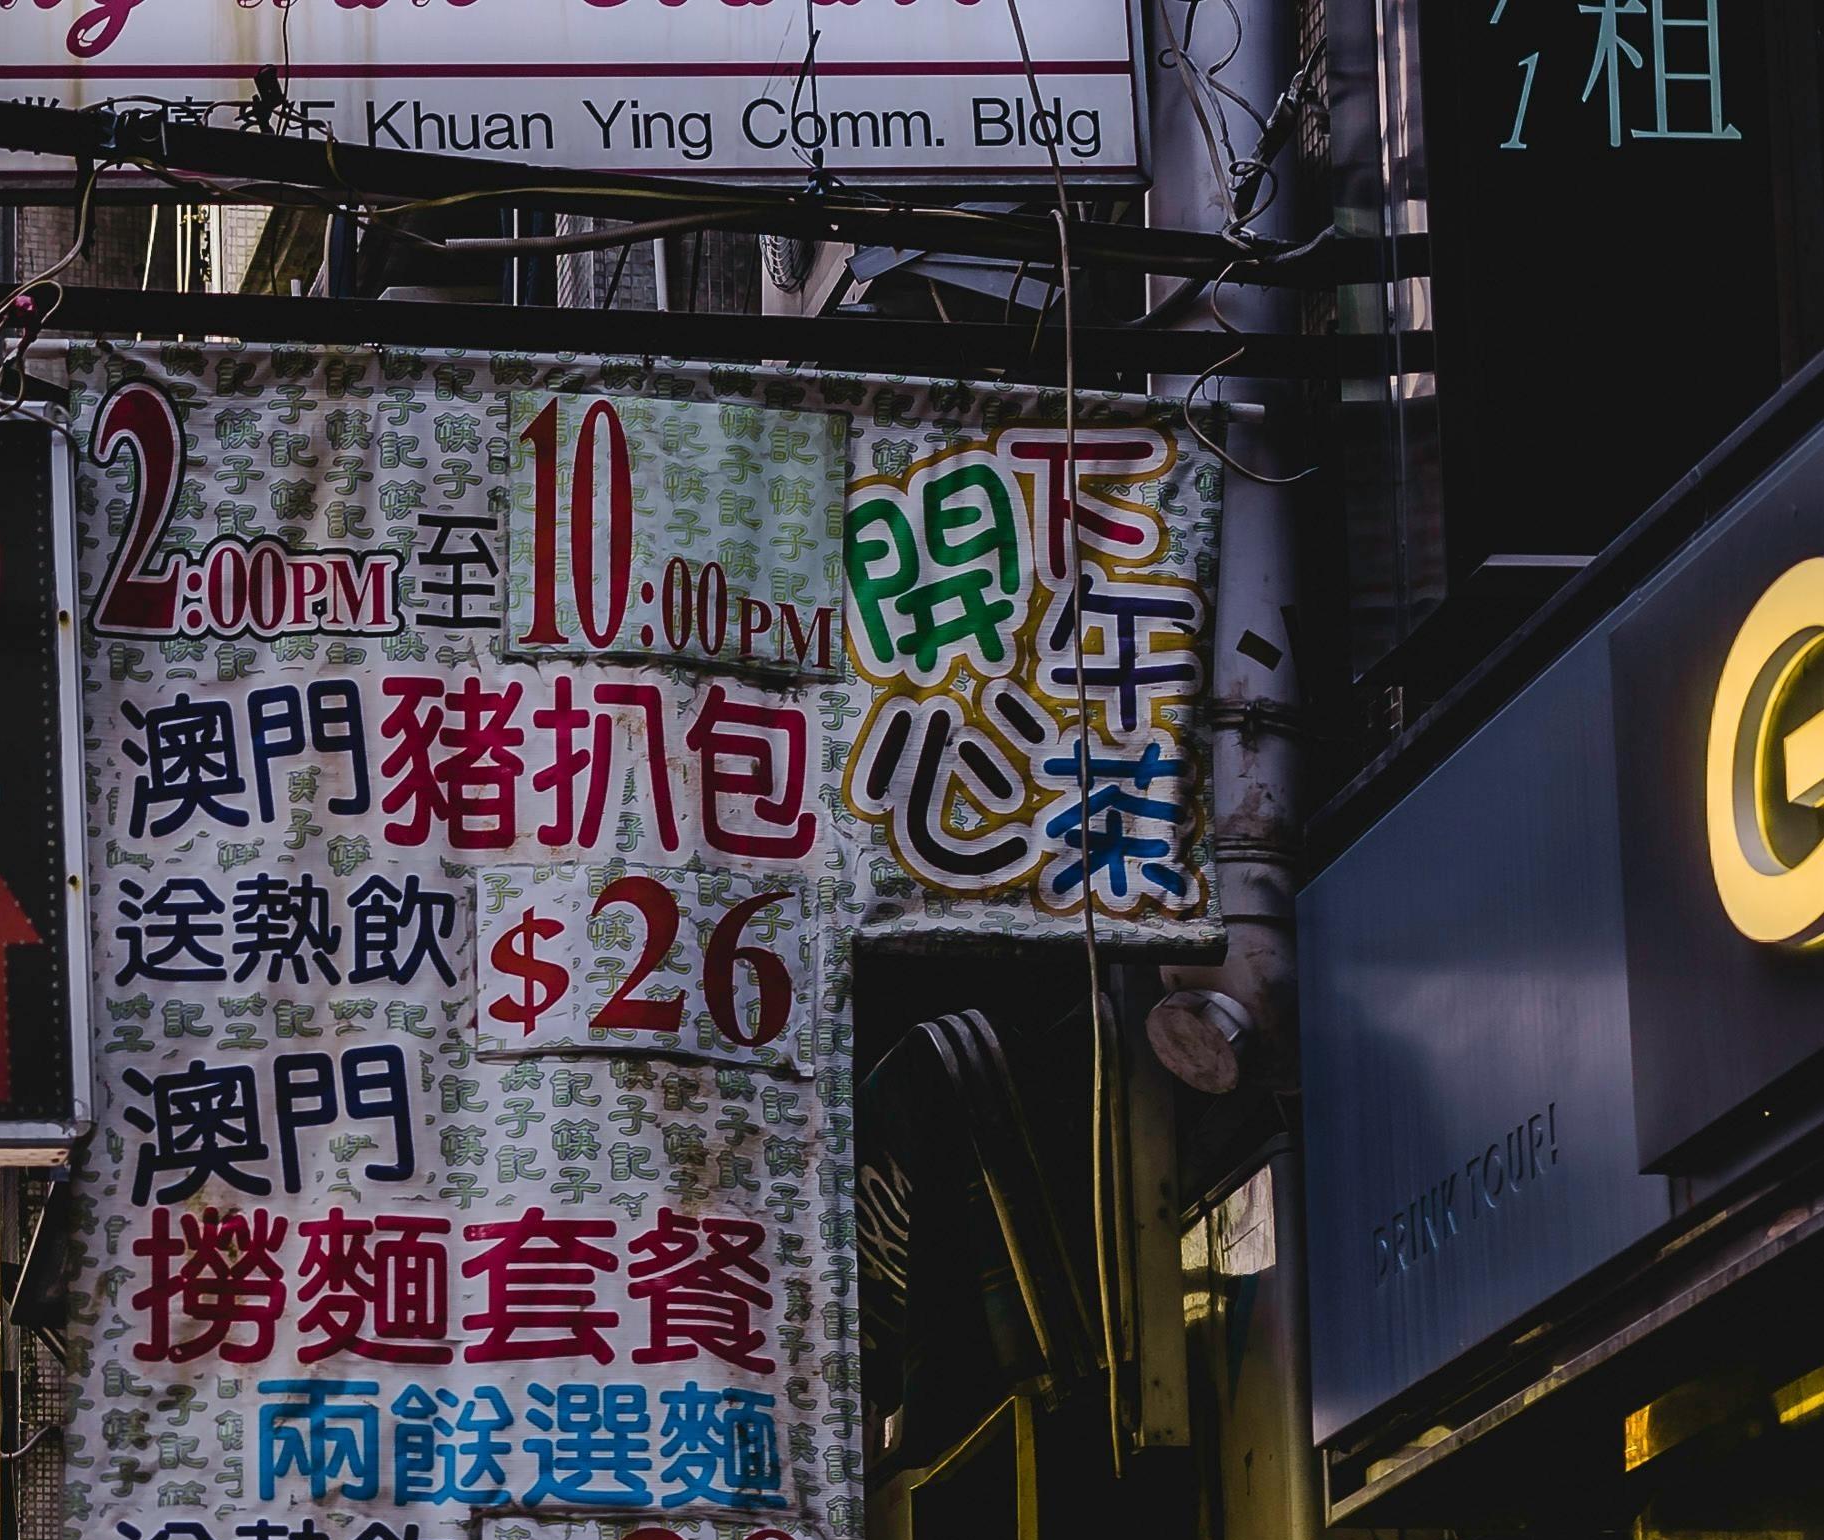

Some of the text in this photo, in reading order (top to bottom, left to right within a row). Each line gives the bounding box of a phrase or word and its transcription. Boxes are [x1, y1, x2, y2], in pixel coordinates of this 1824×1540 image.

[367, 99, 552, 151] Khuan
[583, 99, 712, 159] Ying
[742, 97, 945, 150] Comm.
[972, 97, 1101, 157] Bldg
[89, 378, 837, 672] 2:00PM 至 10:00PM
[113, 874, 798, 1047] 送熱飲 $26
[121, 1045, 414, 1208] 澳門
[133, 1208, 775, 1376] 撈麵套餐
